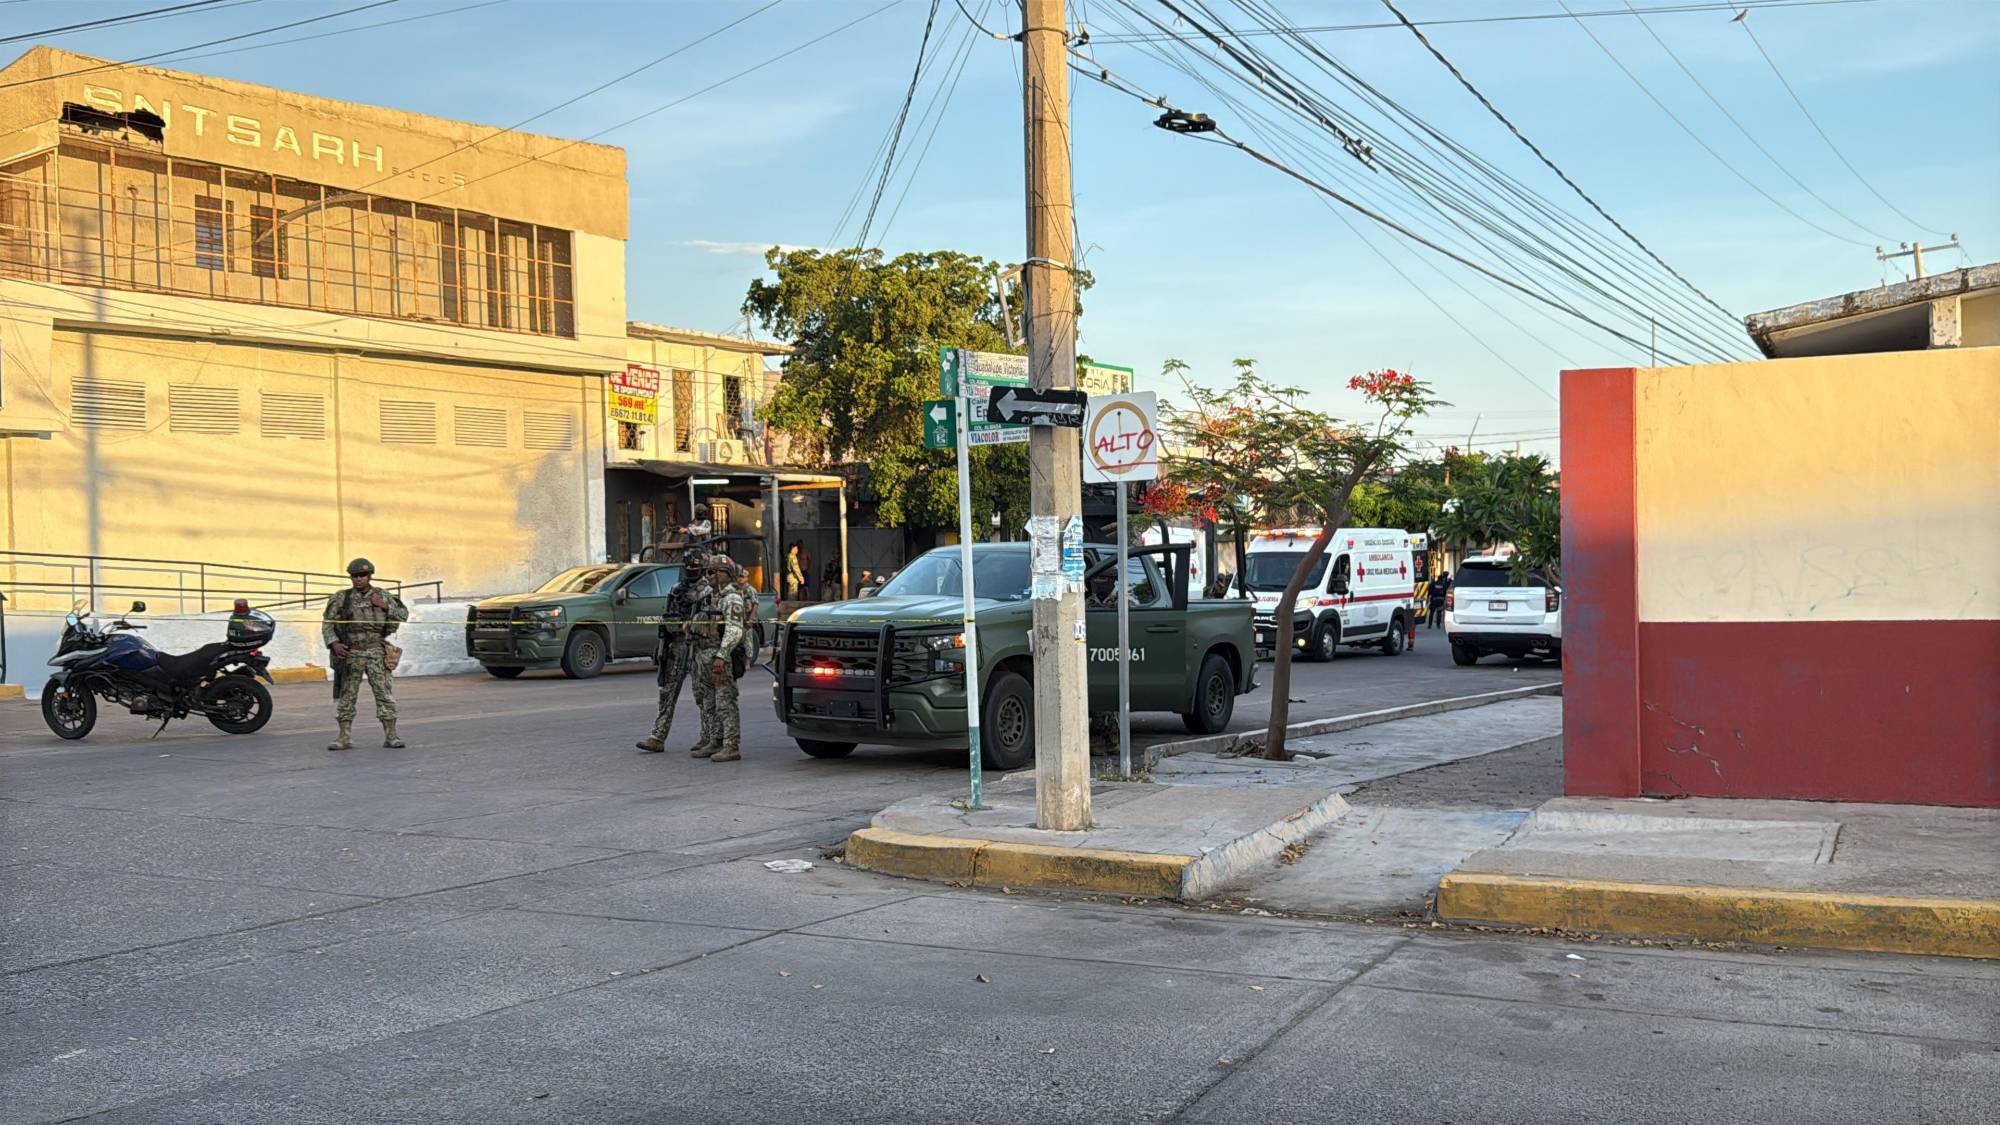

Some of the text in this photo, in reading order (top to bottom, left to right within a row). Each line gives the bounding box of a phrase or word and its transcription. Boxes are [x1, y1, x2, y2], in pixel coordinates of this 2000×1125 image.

[971, 431, 999, 443] VIACOLOR
[1095, 430, 1154, 456] ALTO
[1369, 553, 1394, 561] AMBULANCIA
[1090, 648, 1145, 662] 700561
